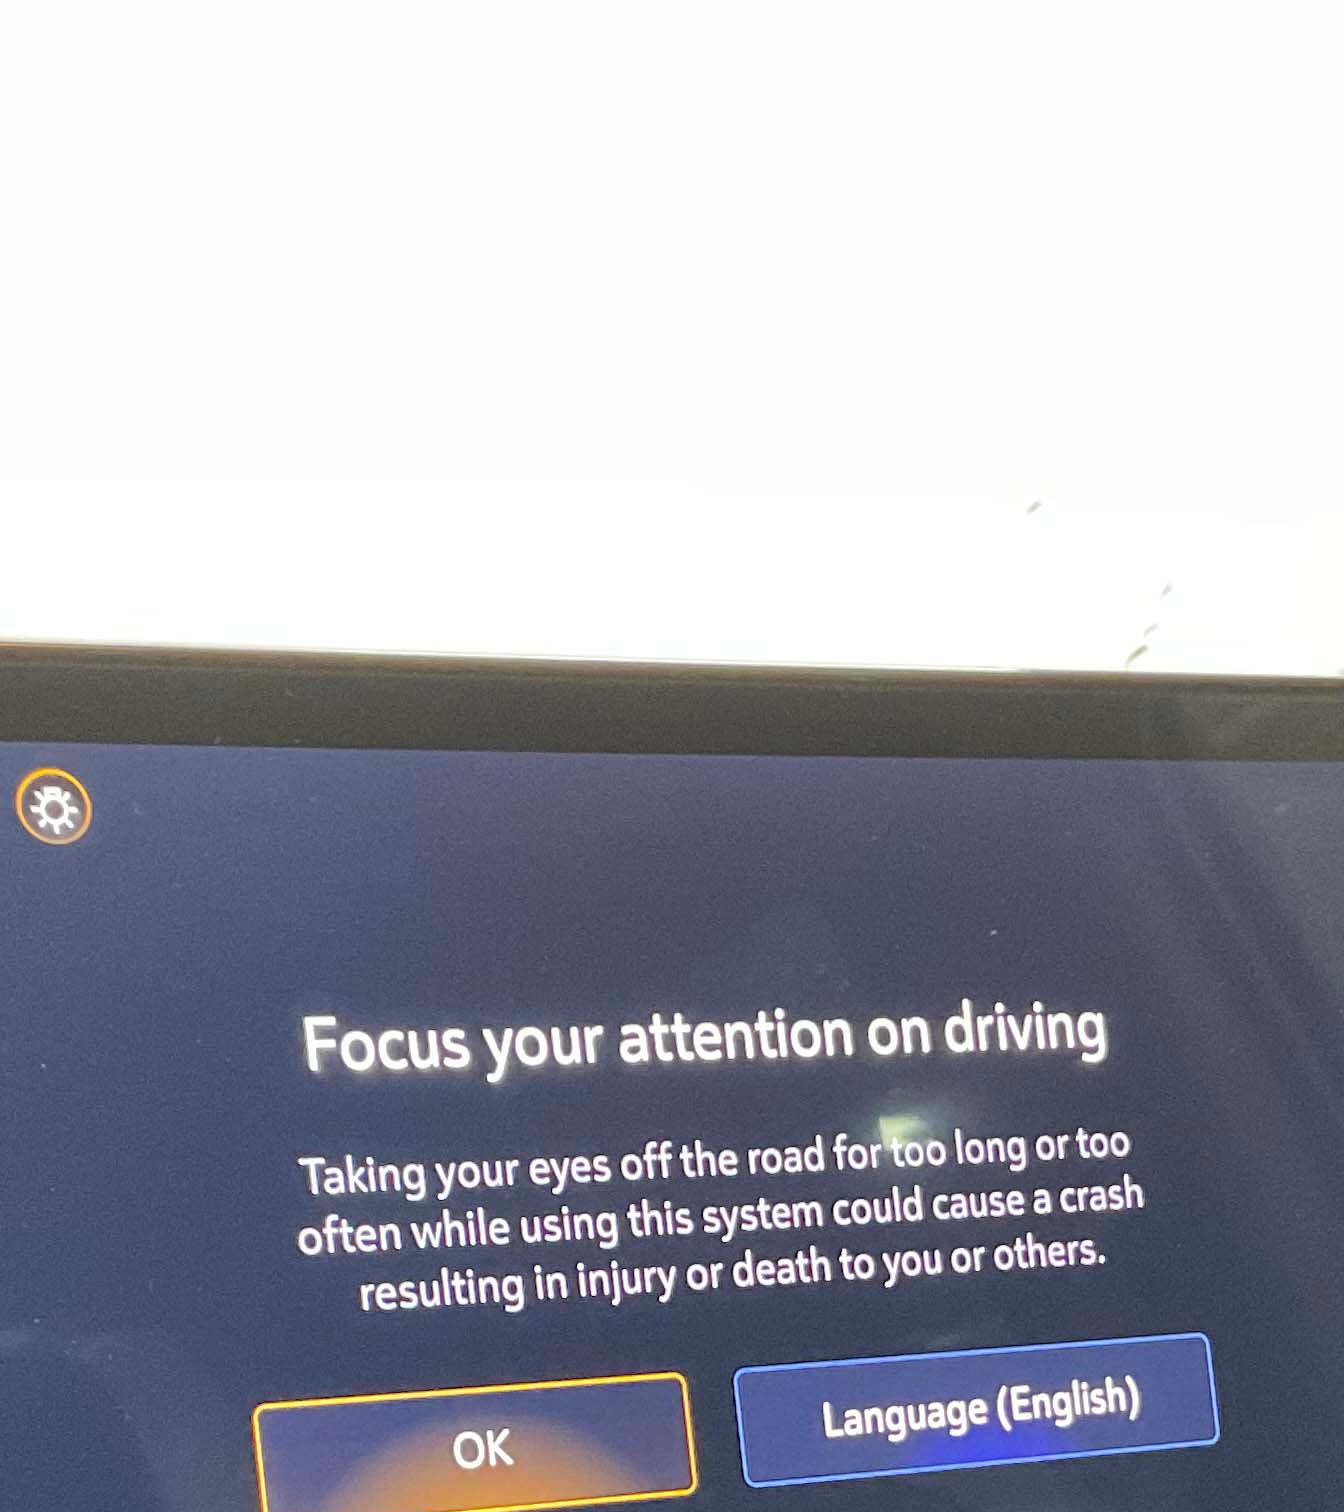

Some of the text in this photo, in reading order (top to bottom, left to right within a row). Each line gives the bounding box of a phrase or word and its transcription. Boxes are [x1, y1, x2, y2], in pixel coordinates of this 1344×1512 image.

[302, 997, 1109, 1086] Focus your attention on driving
[297, 1127, 1131, 1201] Taking your eyes off the road for too long or too
[297, 1173, 1146, 1256] often while using this system could cause a crash
[359, 1233, 1106, 1312] resulting in injury or death to you or others.
[822, 1374, 1142, 1443] Language (English)
[452, 1428, 515, 1470] OK
